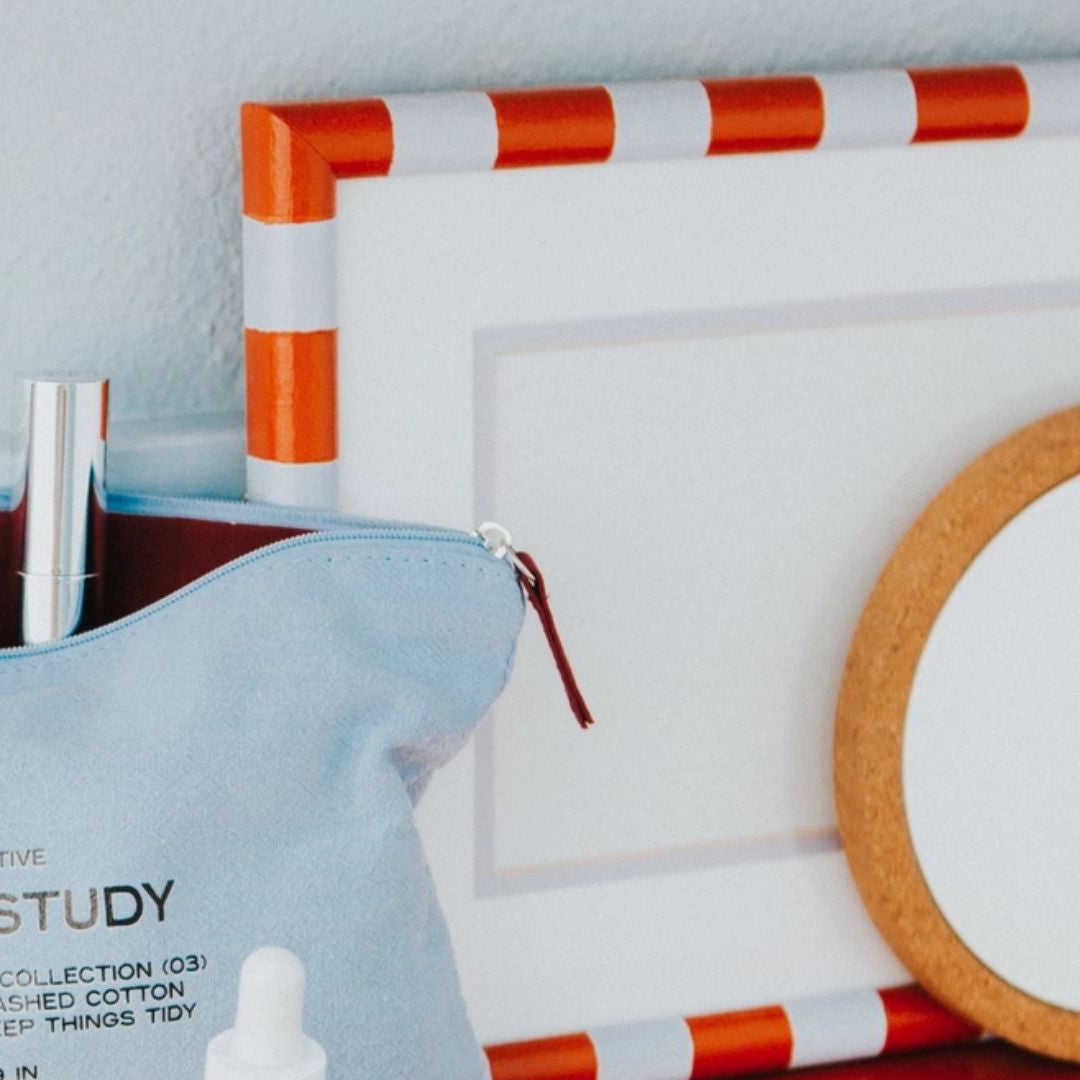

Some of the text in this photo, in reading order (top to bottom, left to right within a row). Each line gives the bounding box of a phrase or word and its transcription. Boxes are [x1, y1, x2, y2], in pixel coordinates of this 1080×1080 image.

[162, 954, 207, 975] (03)
[85, 981, 185, 1007] COTTON
[44, 1010, 135, 1033] THINGS
[145, 1002, 197, 1024] TIDY
[16, 1065, 38, 1080] IN
